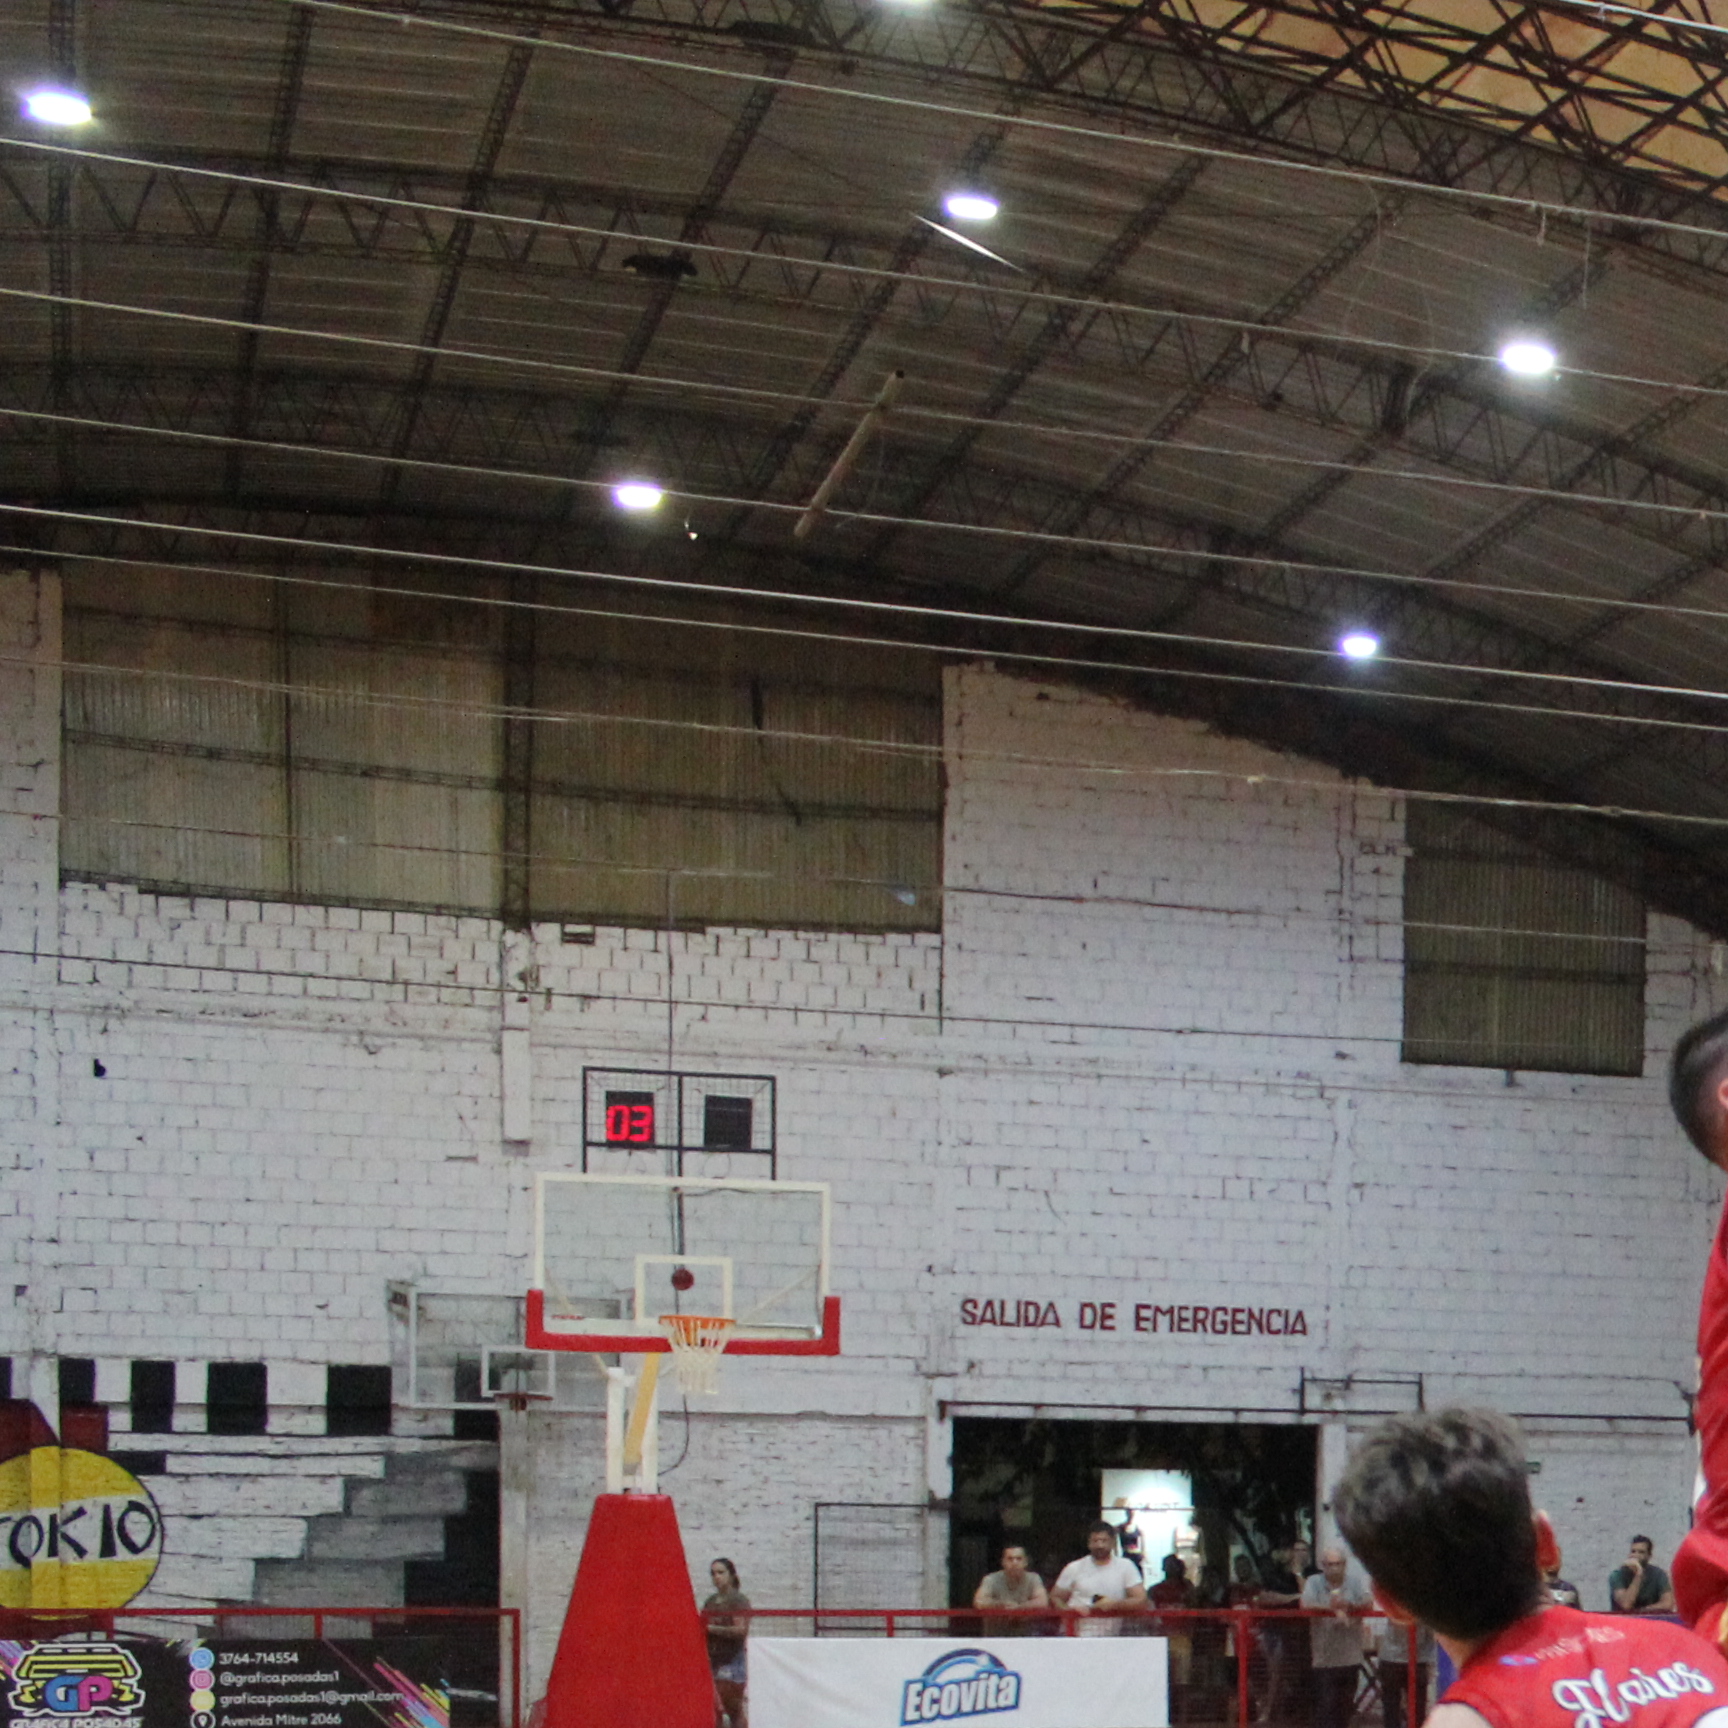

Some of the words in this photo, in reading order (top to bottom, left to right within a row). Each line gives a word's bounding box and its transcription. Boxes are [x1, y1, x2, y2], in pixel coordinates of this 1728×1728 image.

[606, 1104, 654, 1142] 03
[960, 1298, 1062, 1328] SALIDA
[1079, 1302, 1117, 1331] DE
[1134, 1304, 1308, 1336] EMERGENCIA
[0, 1500, 157, 1570] OKIO
[219, 1652, 299, 1665] 3764-714554
[219, 1670, 340, 1687] @grafica.posadas1
[904, 1672, 1019, 1722] Ecovita
[220, 1713, 273, 1727] Avenida
[275, 1713, 308, 1727] Mitre
[310, 1712, 342, 1726] 2066
